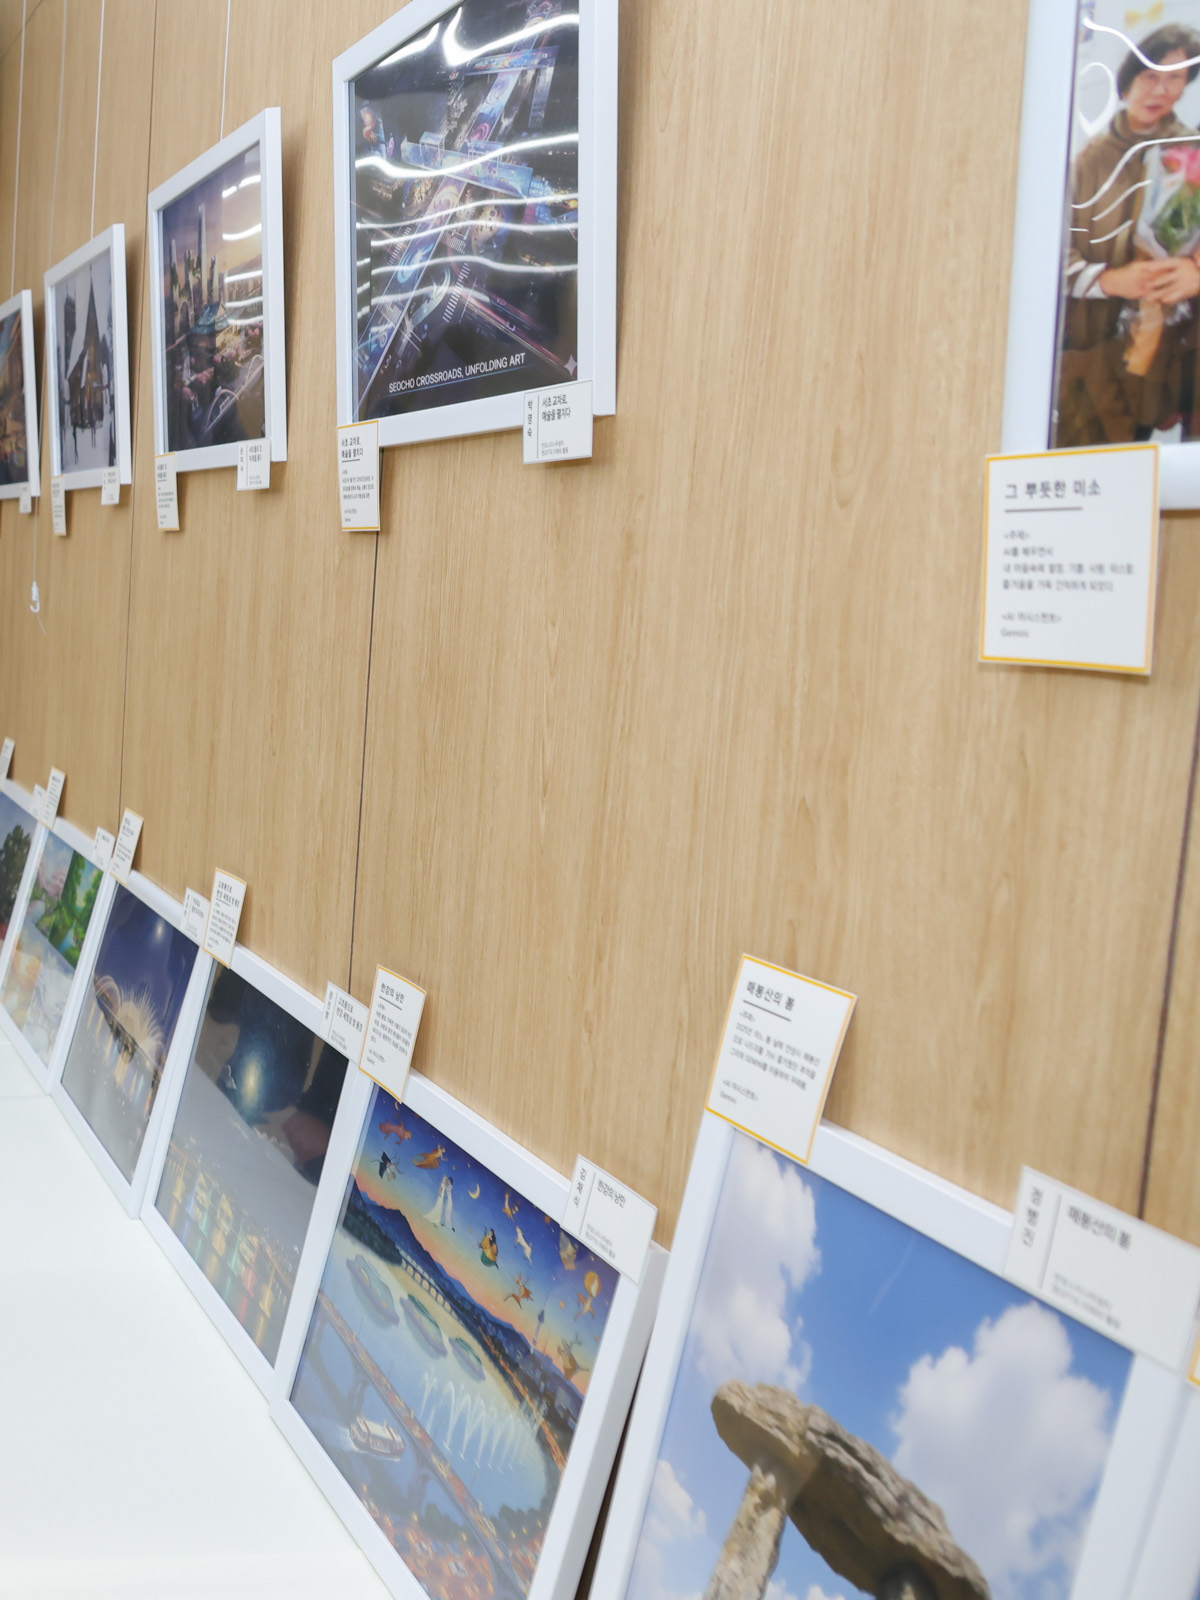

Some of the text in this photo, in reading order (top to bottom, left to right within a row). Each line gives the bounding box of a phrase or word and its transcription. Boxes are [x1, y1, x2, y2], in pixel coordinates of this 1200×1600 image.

[388, 352, 526, 393] SEOCHO CROSSROADS, UNFOLDING ART
[1005, 479, 1101, 498] 그 뿌듯한 미소
[381, 983, 404, 1004] 한강의 낭만
[785, 997, 795, 1011] 봄
[597, 1180, 626, 1208] 한강의 낭만
[1118, 1231, 1130, 1249] 봄
